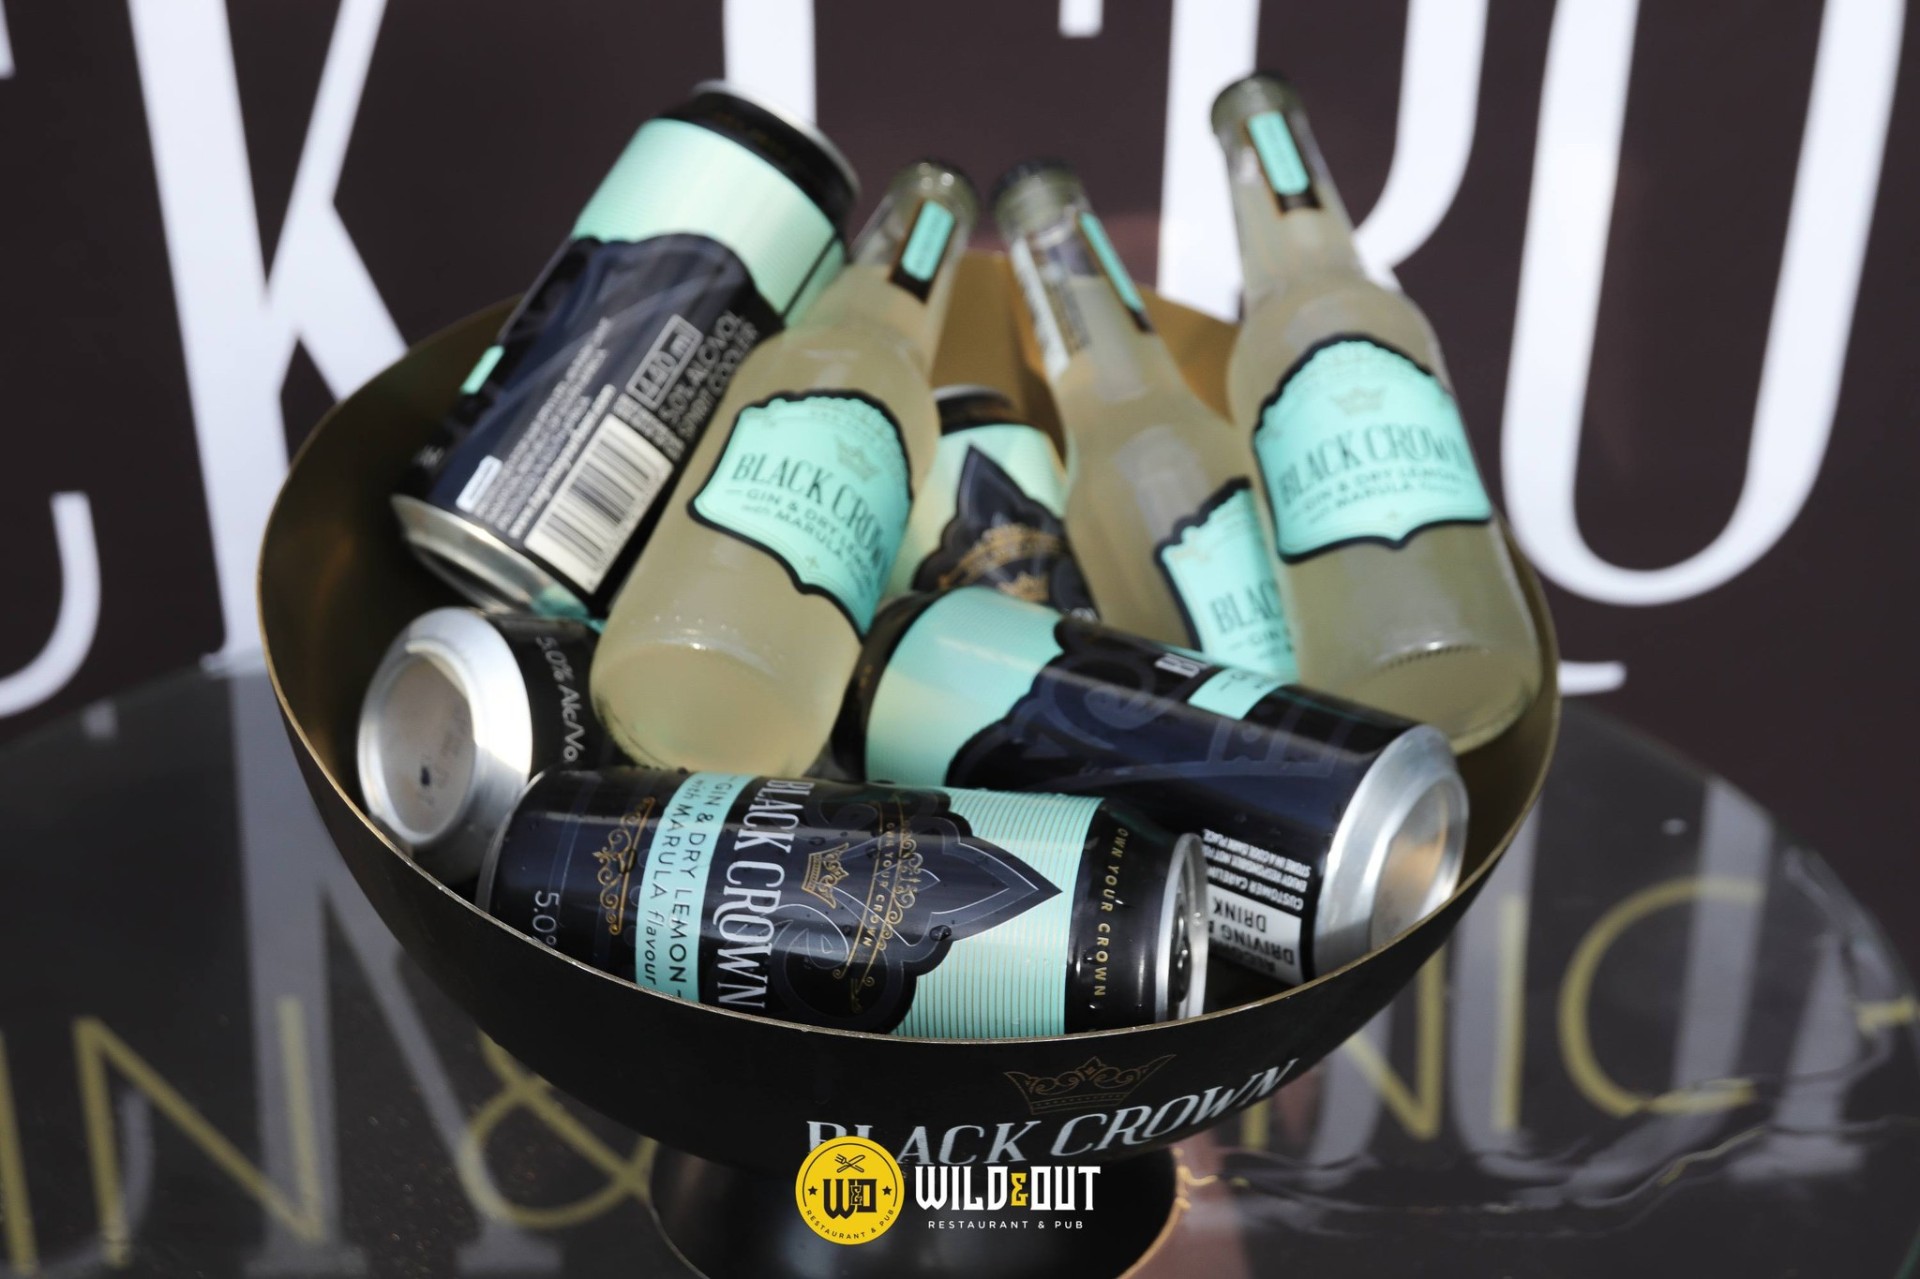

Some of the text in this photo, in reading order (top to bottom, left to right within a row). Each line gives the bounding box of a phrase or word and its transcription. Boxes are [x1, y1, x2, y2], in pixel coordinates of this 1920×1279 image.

[731, 453, 834, 505] BLACK
[745, 487, 782, 505] GIN
[786, 502, 798, 512] &
[804, 508, 839, 535] DRY
[774, 509, 843, 562] MARULA
[650, 803, 692, 900] MARULA
[668, 782, 733, 984] GIN & DRY LEMON
[712, 779, 815, 1008] BLACK CROWN
[861, 894, 886, 948] CROWN
[1093, 827, 1129, 997] OWN YOUR CROWN
[1213, 896, 1267, 933] DRINK
[644, 909, 666, 986] flavour
[1220, 923, 1295, 966] DRIVING
[1050, 1057, 1300, 1157] CROWN
